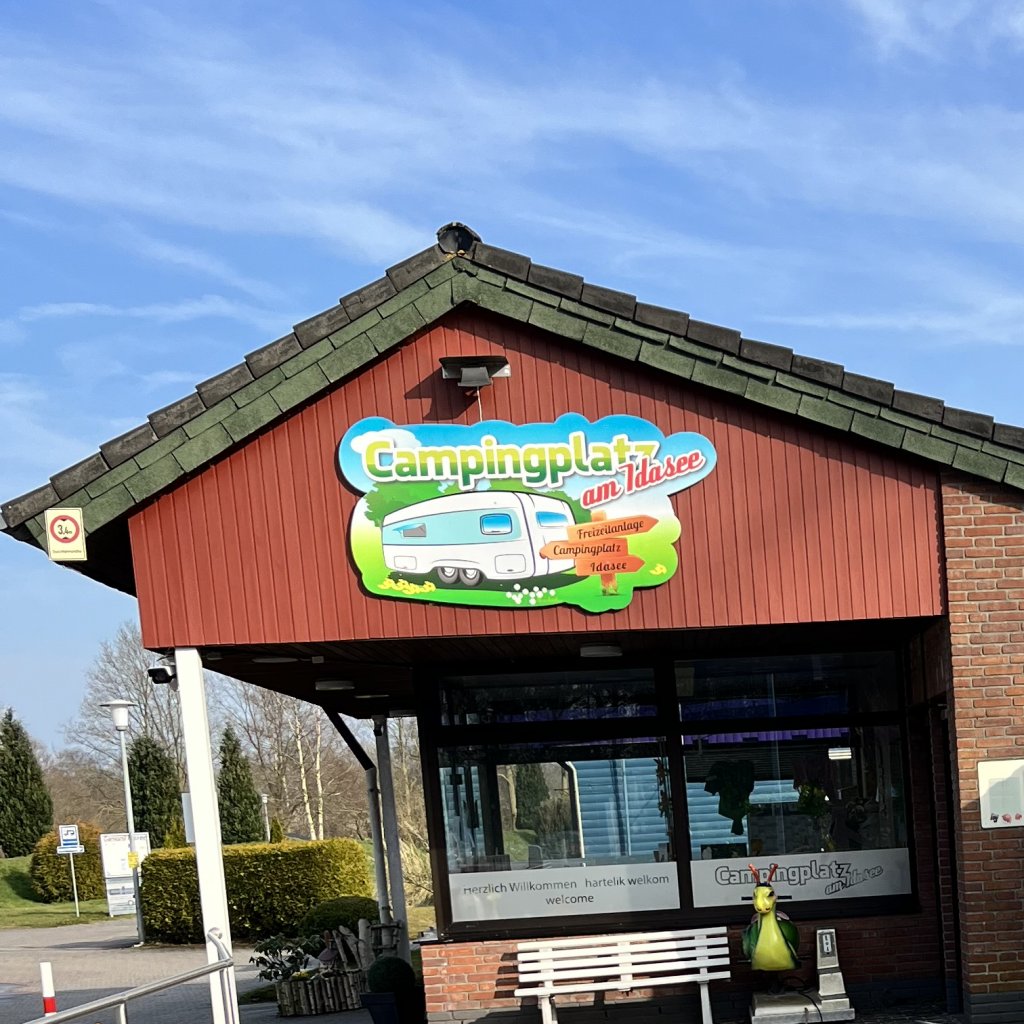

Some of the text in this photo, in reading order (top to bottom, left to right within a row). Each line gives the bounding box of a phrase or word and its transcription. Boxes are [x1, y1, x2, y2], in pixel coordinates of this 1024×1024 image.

[363, 432, 659, 488] Campingplatz
[582, 450, 703, 507] am Idasee
[577, 520, 645, 539] Freizeitanlage
[553, 543, 621, 557] Campingplatz
[590, 562, 627, 572] Idasee
[509, 881, 577, 893] Willkommen
[627, 875, 669, 886] welkom
[545, 894, 594, 905] welcome
